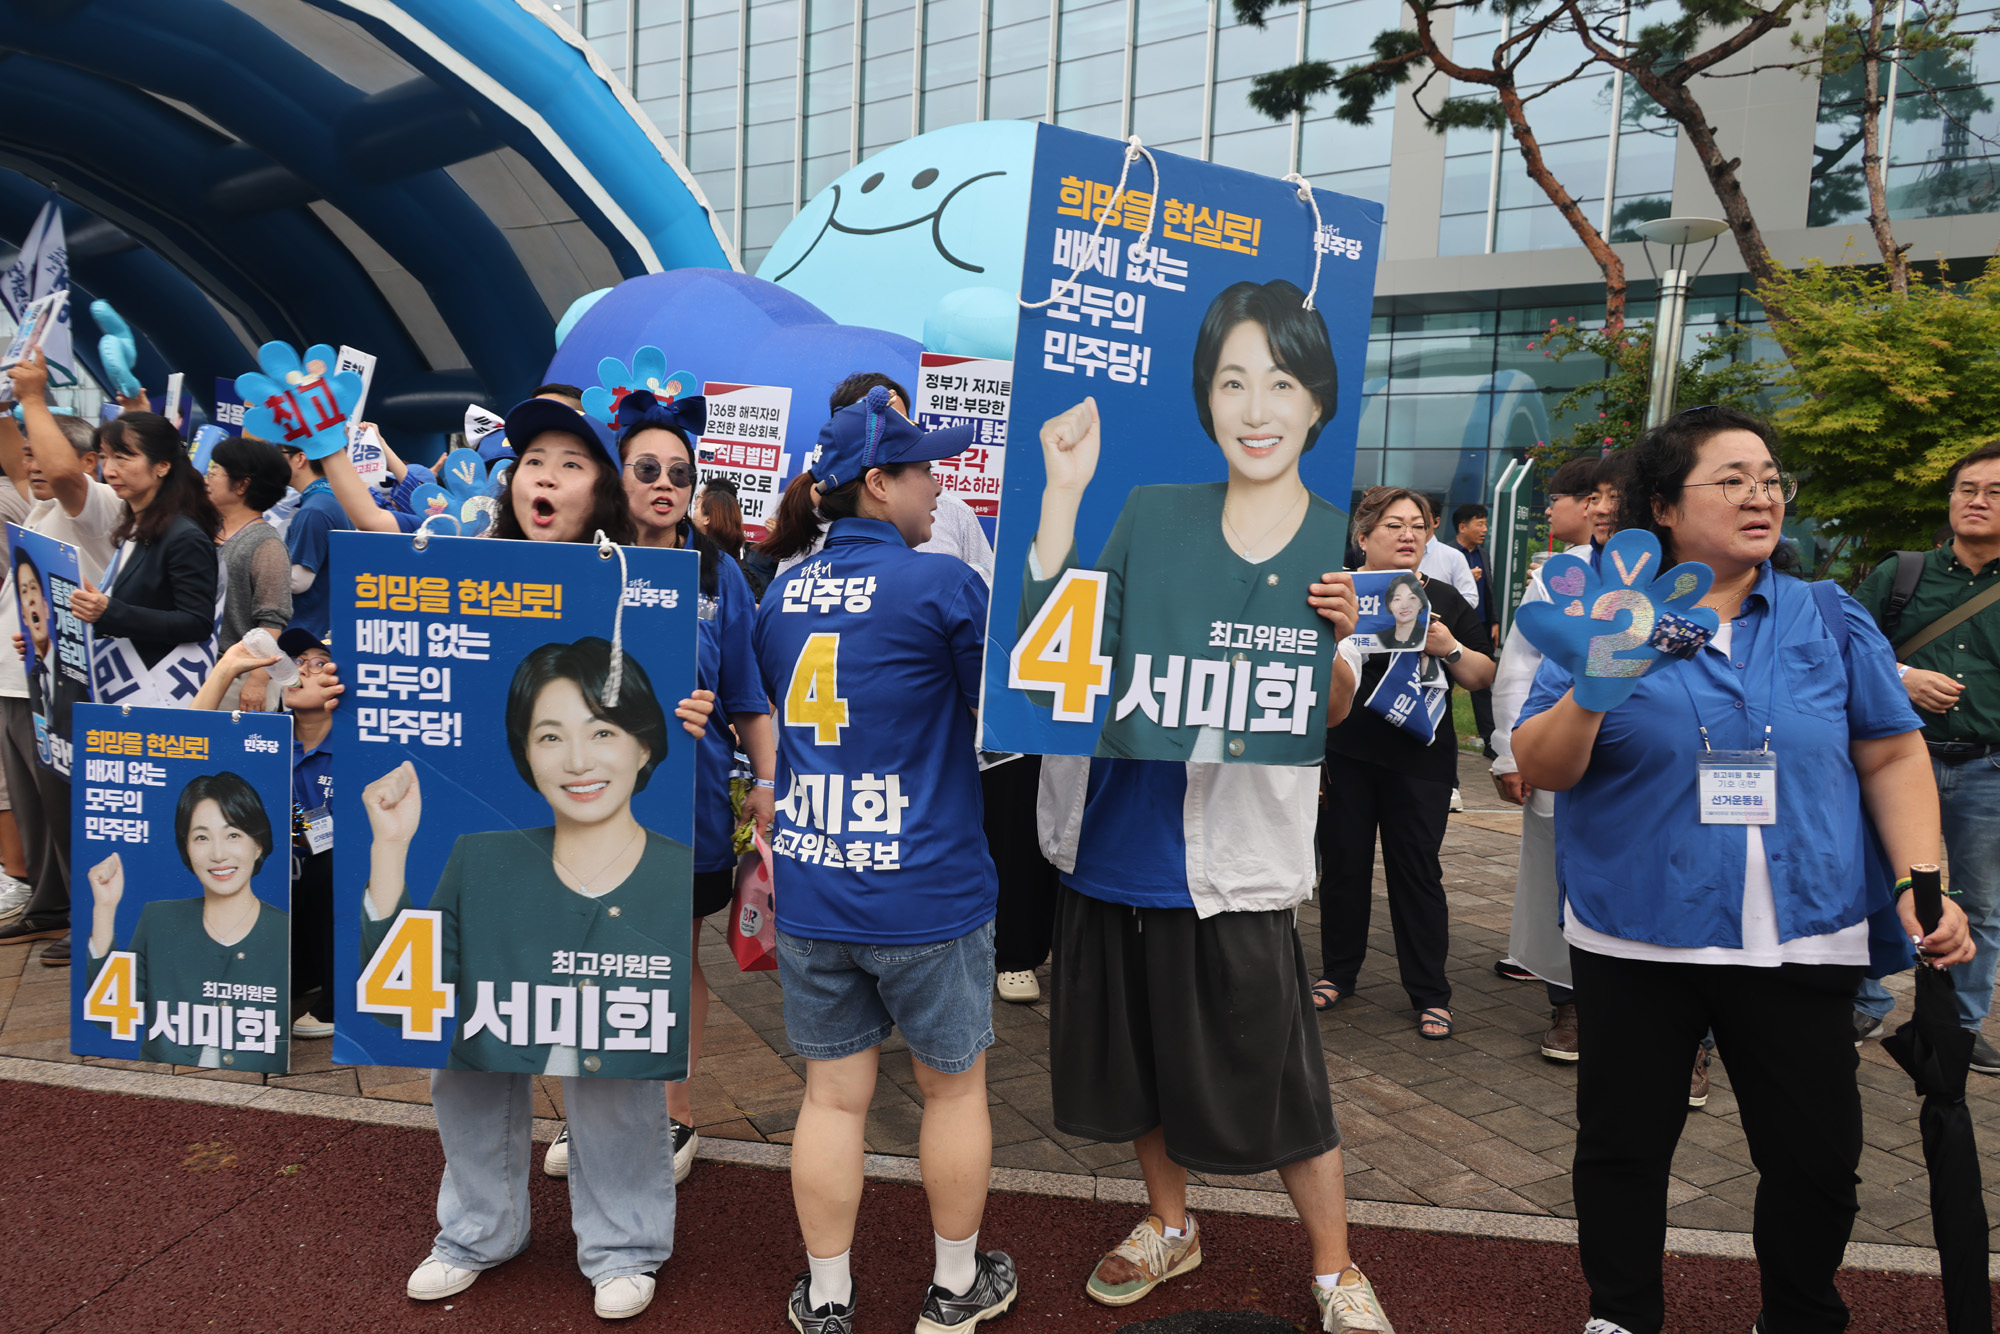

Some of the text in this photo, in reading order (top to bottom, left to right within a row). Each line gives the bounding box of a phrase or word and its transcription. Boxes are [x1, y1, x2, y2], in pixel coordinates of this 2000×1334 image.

[1057, 175, 1262, 257] 희망을 현실로!
[1052, 227, 1189, 292] 배제 없는
[1313, 230, 1363, 260] 민주당
[1046, 278, 1146, 335] 모두의
[1043, 329, 1151, 386] 민주당!
[925, 373, 1011, 397] 정부가 저지른
[264, 377, 347, 442] 최고
[708, 403, 780, 422] 136명 해직자의
[930, 394, 1005, 416] 위법·부당한
[707, 420, 781, 440] 온전한 원상회복,
[800, 560, 832, 580] 더불어
[1610, 550, 1652, 586] V
[355, 573, 563, 619] 희망을 현실로!
[624, 586, 679, 609] 민주당
[782, 576, 877, 613] 민주당
[356, 619, 491, 660] 배제 없는
[1008, 567, 1113, 723] 4
[1208, 620, 1319, 656] 최고위원은
[1585, 589, 1655, 678] 2
[356, 663, 451, 702] 모두의
[784, 632, 850, 746] 4
[1115, 653, 1317, 735] 서미화
[32, 711, 52, 765] 5
[85, 729, 209, 760] 희망을 현실로!
[357, 707, 463, 747] 민주당!
[244, 739, 279, 753] 민주당
[85, 759, 167, 786] 배제 없는
[1718, 780, 1736, 788] 기호
[85, 788, 142, 814] 모두의
[1712, 795, 1763, 806] 선거운동원
[85, 816, 150, 844] 민주당!
[356, 908, 455, 1042] 4
[551, 950, 672, 980] 최고위원은
[83, 950, 145, 1041] 4
[202, 980, 277, 1003] 최고위원은
[149, 1000, 281, 1054] 서미화
[463, 980, 677, 1054] 서미화
